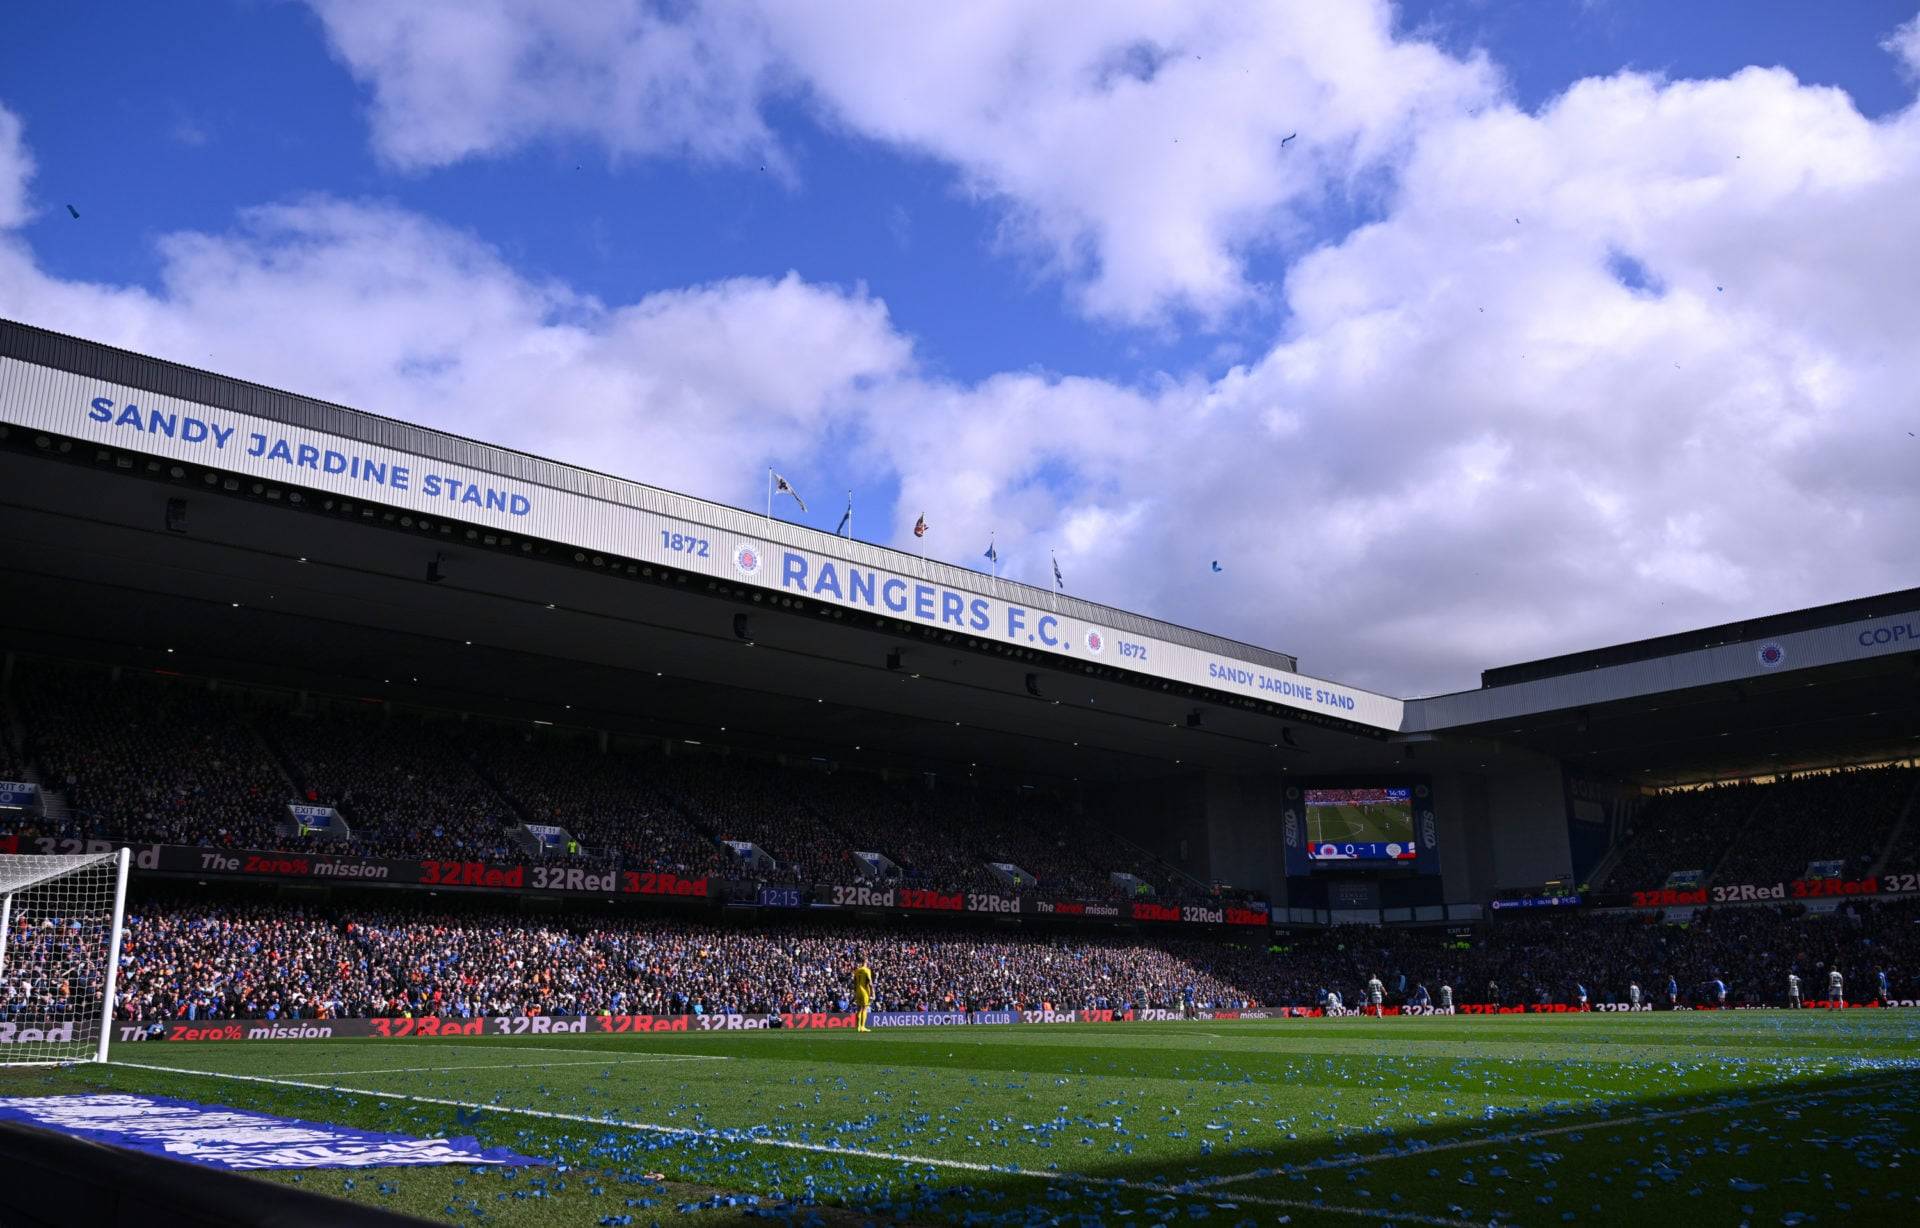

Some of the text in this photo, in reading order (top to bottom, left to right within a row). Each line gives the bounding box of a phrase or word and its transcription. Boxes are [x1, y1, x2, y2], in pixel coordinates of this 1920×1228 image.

[88, 397, 531, 516] SANDY JARDINE STAND
[661, 530, 709, 558] 1872
[783, 551, 1070, 651] RANGERS F.C.
[1858, 624, 1920, 647] COPL
[1117, 640, 1148, 660] 1872
[1209, 663, 1355, 711] SANDY JARDINE STAND
[295, 806, 326, 816] EXIT 10
[1345, 843, 1355, 855] 0
[1370, 843, 1377, 855] 1
[200, 853, 389, 879] The Zero% mission
[419, 860, 524, 888] 32Red
[531, 866, 617, 892] 32Red
[624, 871, 708, 896] 32Red
[1791, 876, 1879, 898] 32Red
[1884, 874, 1920, 892] 32
[761, 888, 799, 907] 12:15
[832, 886, 895, 907] 32Red
[900, 888, 964, 911] 32Red
[1633, 888, 1708, 908] 32Red
[1712, 883, 1785, 902] 32Red
[967, 894, 1021, 913] 32Red
[1037, 901, 1054, 913] The
[1085, 905, 1119, 917] mission
[1132, 904, 1180, 921] 32Red
[1183, 906, 1224, 923] 32Red
[598, 1015, 688, 1033] 32Red
[696, 1013, 770, 1030] 32Red
[780, 1013, 857, 1029] 32Red
[873, 1014, 925, 1027] RANGERS
[984, 1014, 1010, 1024] CLUB
[1023, 1009, 1075, 1023] 32Red
[1081, 1009, 1134, 1022] 32Rd
[1198, 1011, 1213, 1020] The
[120, 1022, 333, 1042] Th Zero% mission
[369, 1017, 484, 1037] 32Red
[493, 1016, 587, 1035] 32Red
